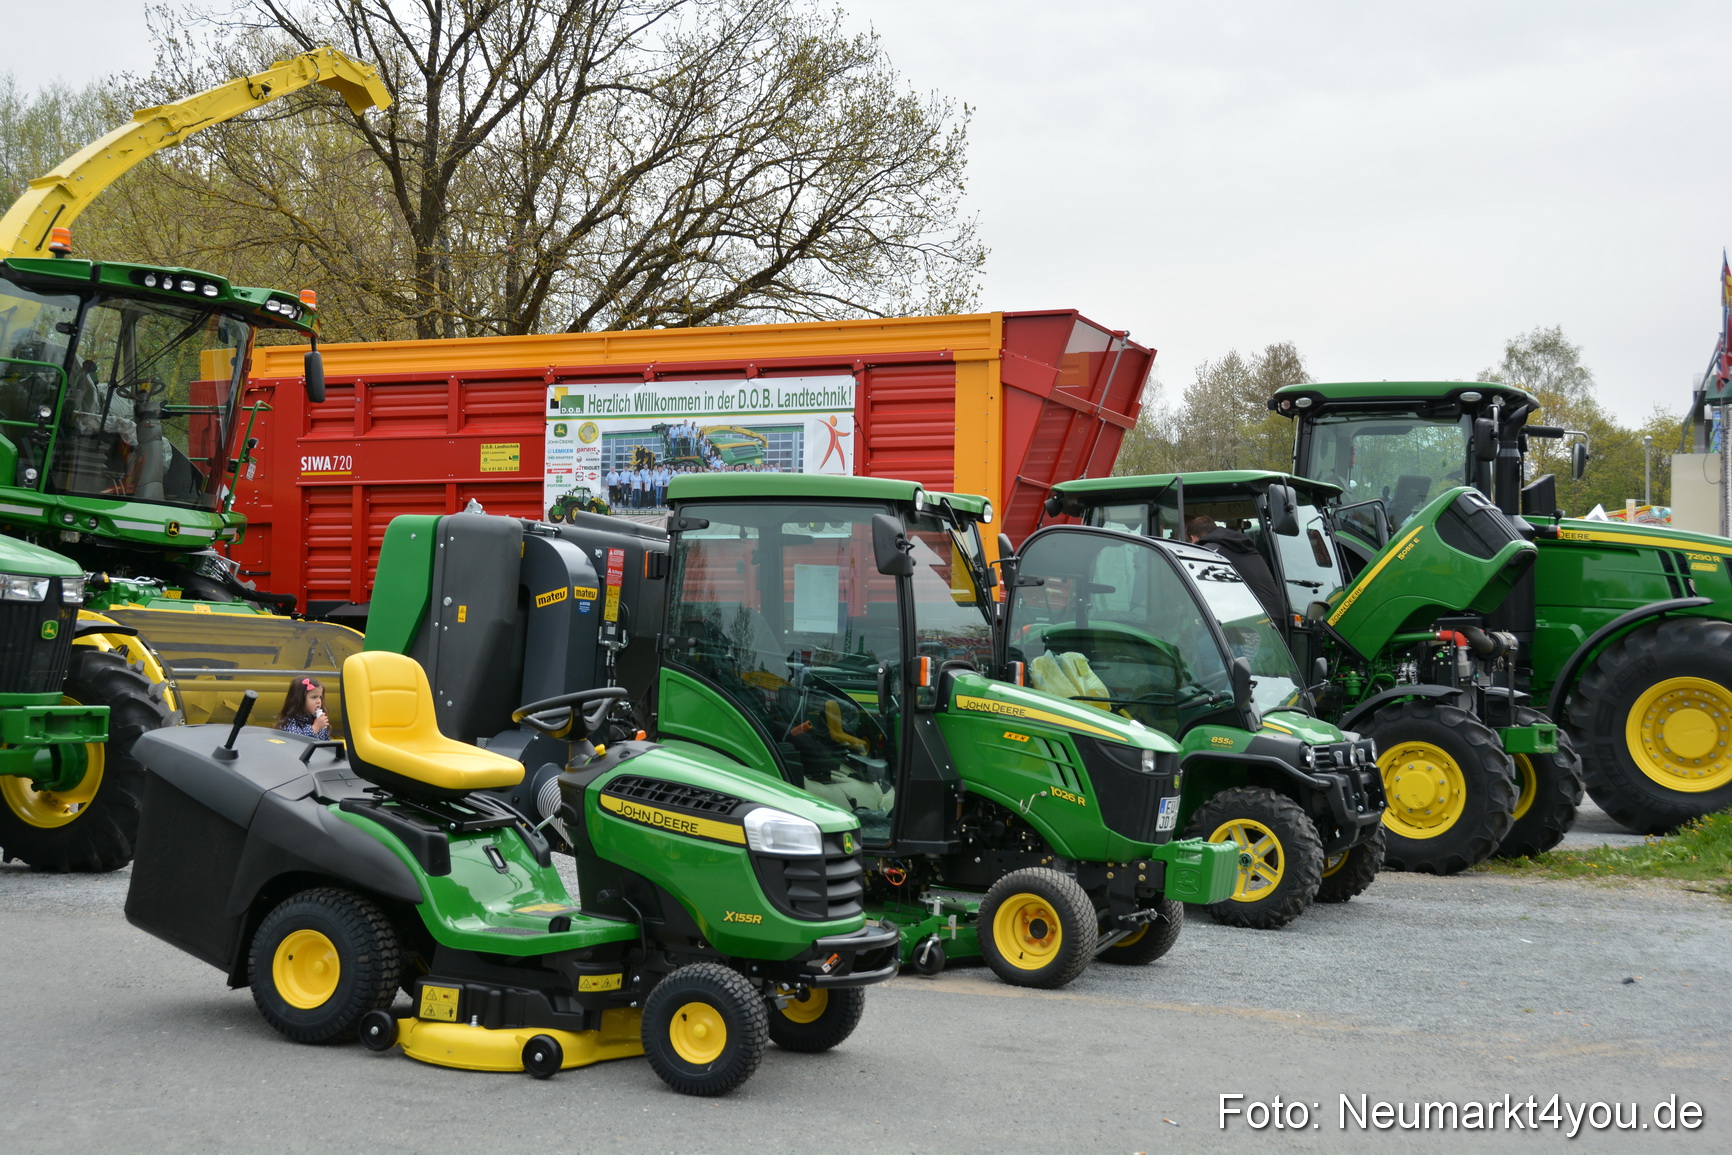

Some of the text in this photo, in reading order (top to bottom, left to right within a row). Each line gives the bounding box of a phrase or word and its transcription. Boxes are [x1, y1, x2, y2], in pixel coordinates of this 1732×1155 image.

[588, 386, 852, 413] Herzlich Willkommen in der D.O.B. Landtechnik!
[538, 591, 565, 605] matev
[575, 589, 596, 599] matev
[1331, 586, 1364, 624] JOHN DEERE
[963, 700, 1027, 717] JOHN DEERE
[1050, 785, 1087, 806] 1026 R
[617, 801, 699, 834] JOHN DEERE
[723, 911, 763, 925] X155R
